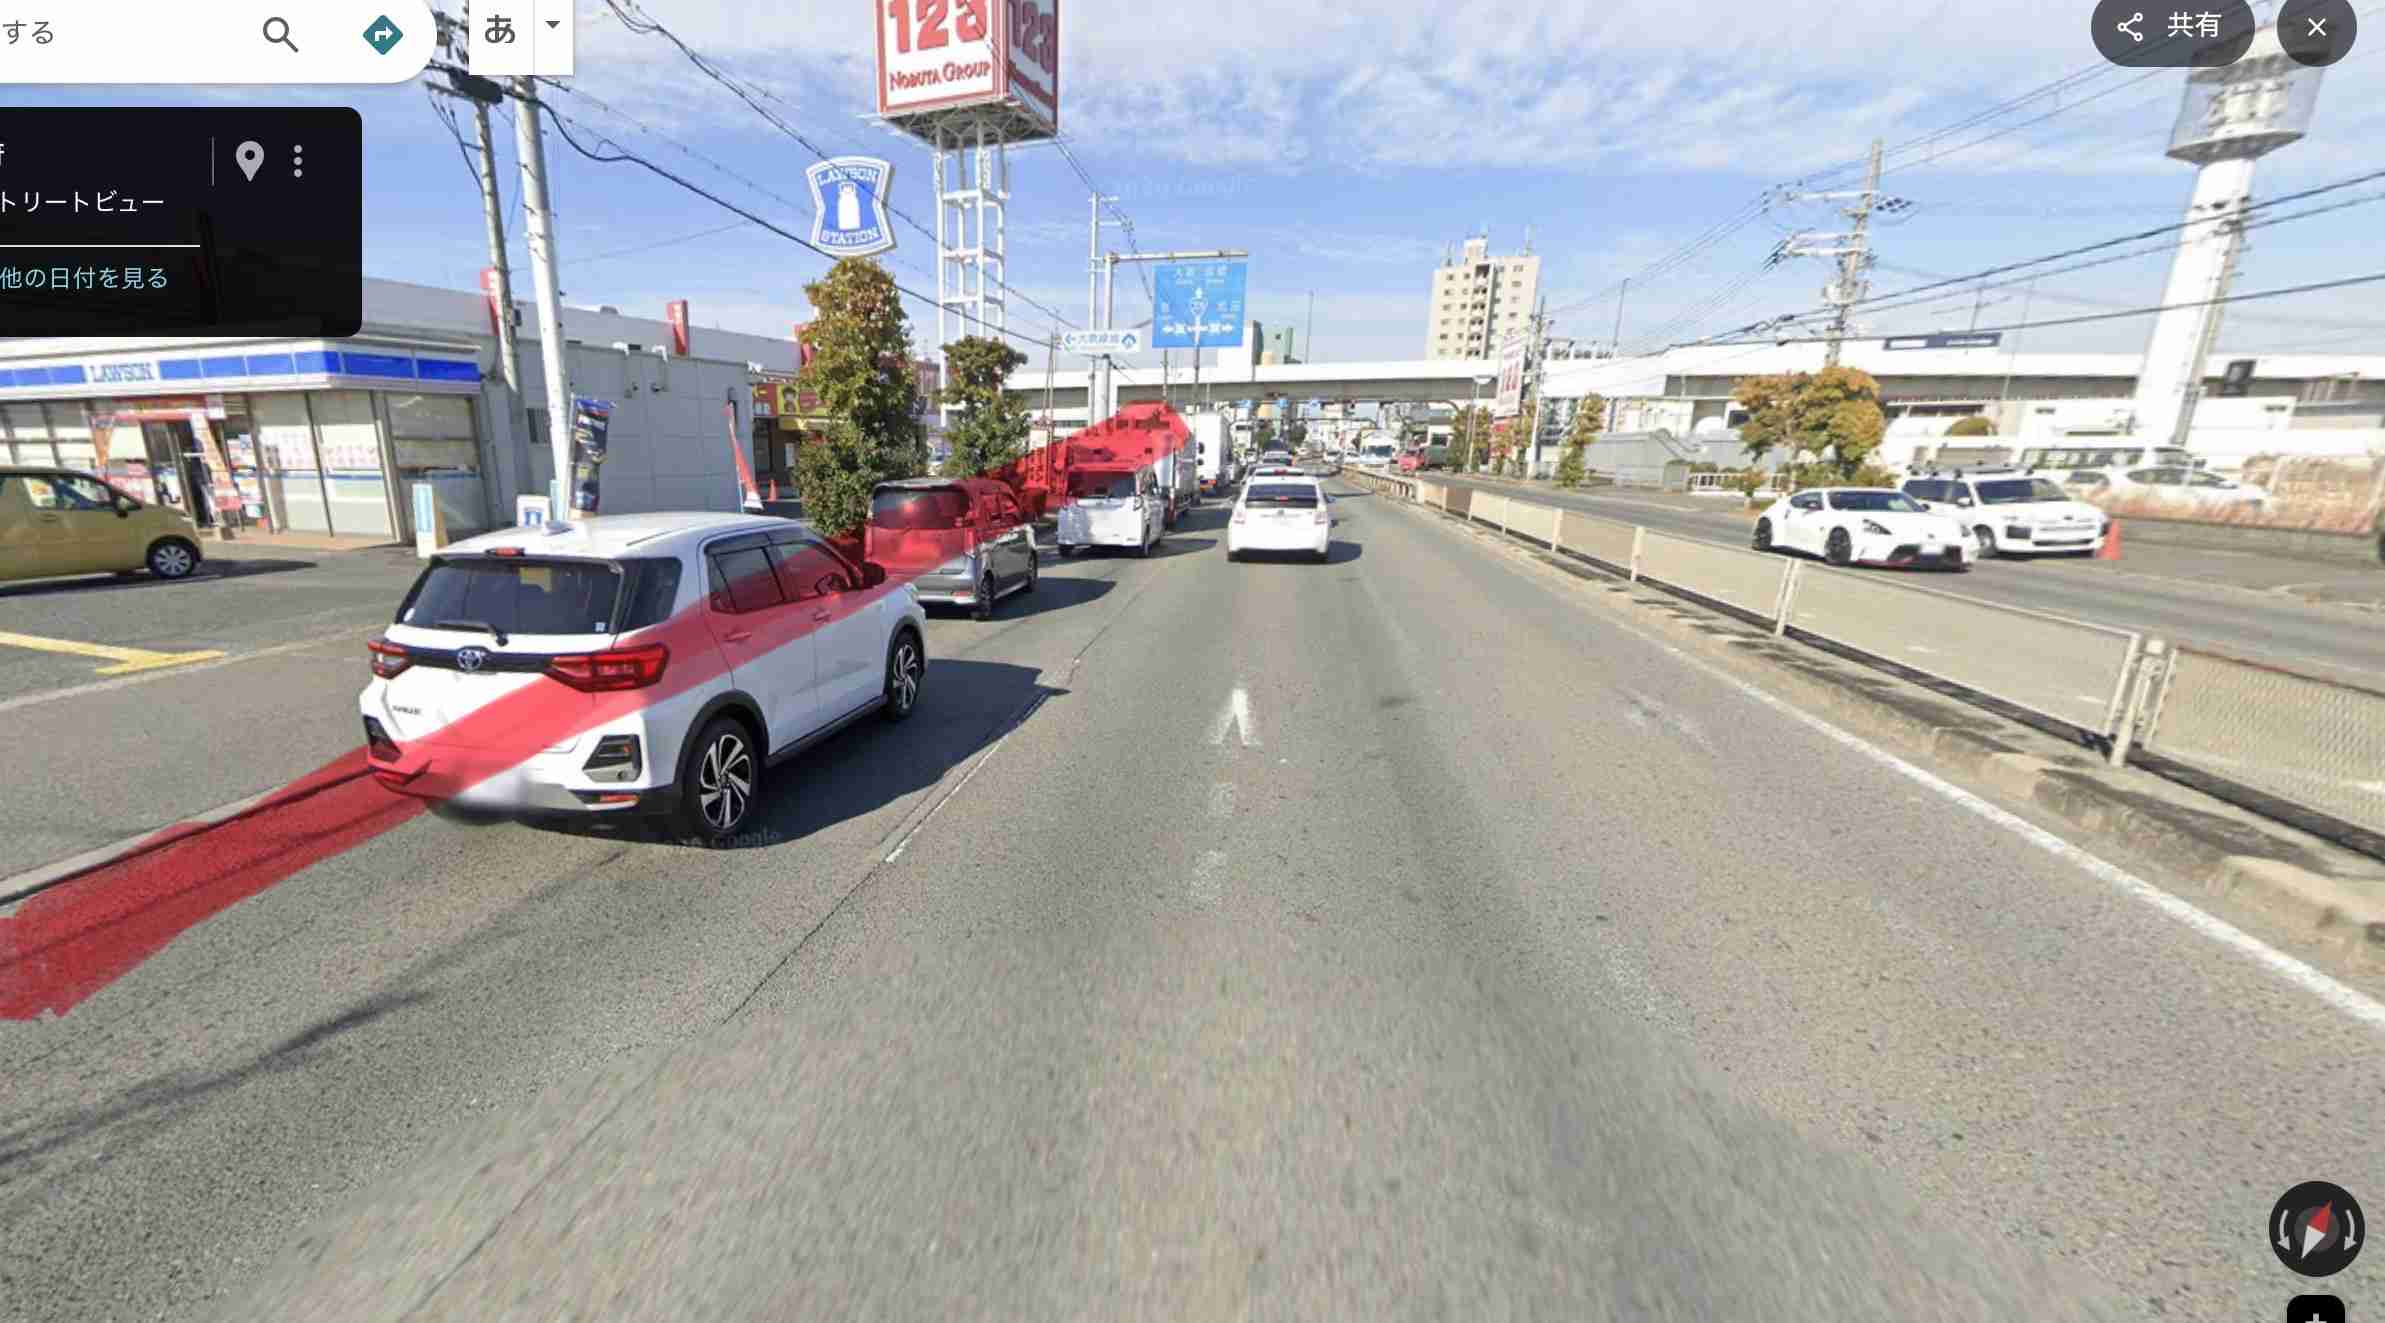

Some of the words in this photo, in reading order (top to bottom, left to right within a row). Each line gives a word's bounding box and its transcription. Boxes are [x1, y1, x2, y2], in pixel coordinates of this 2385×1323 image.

[816, 166, 879, 184] LAWSON
[819, 226, 881, 248] STATION
[89, 361, 156, 384] LAWSON
